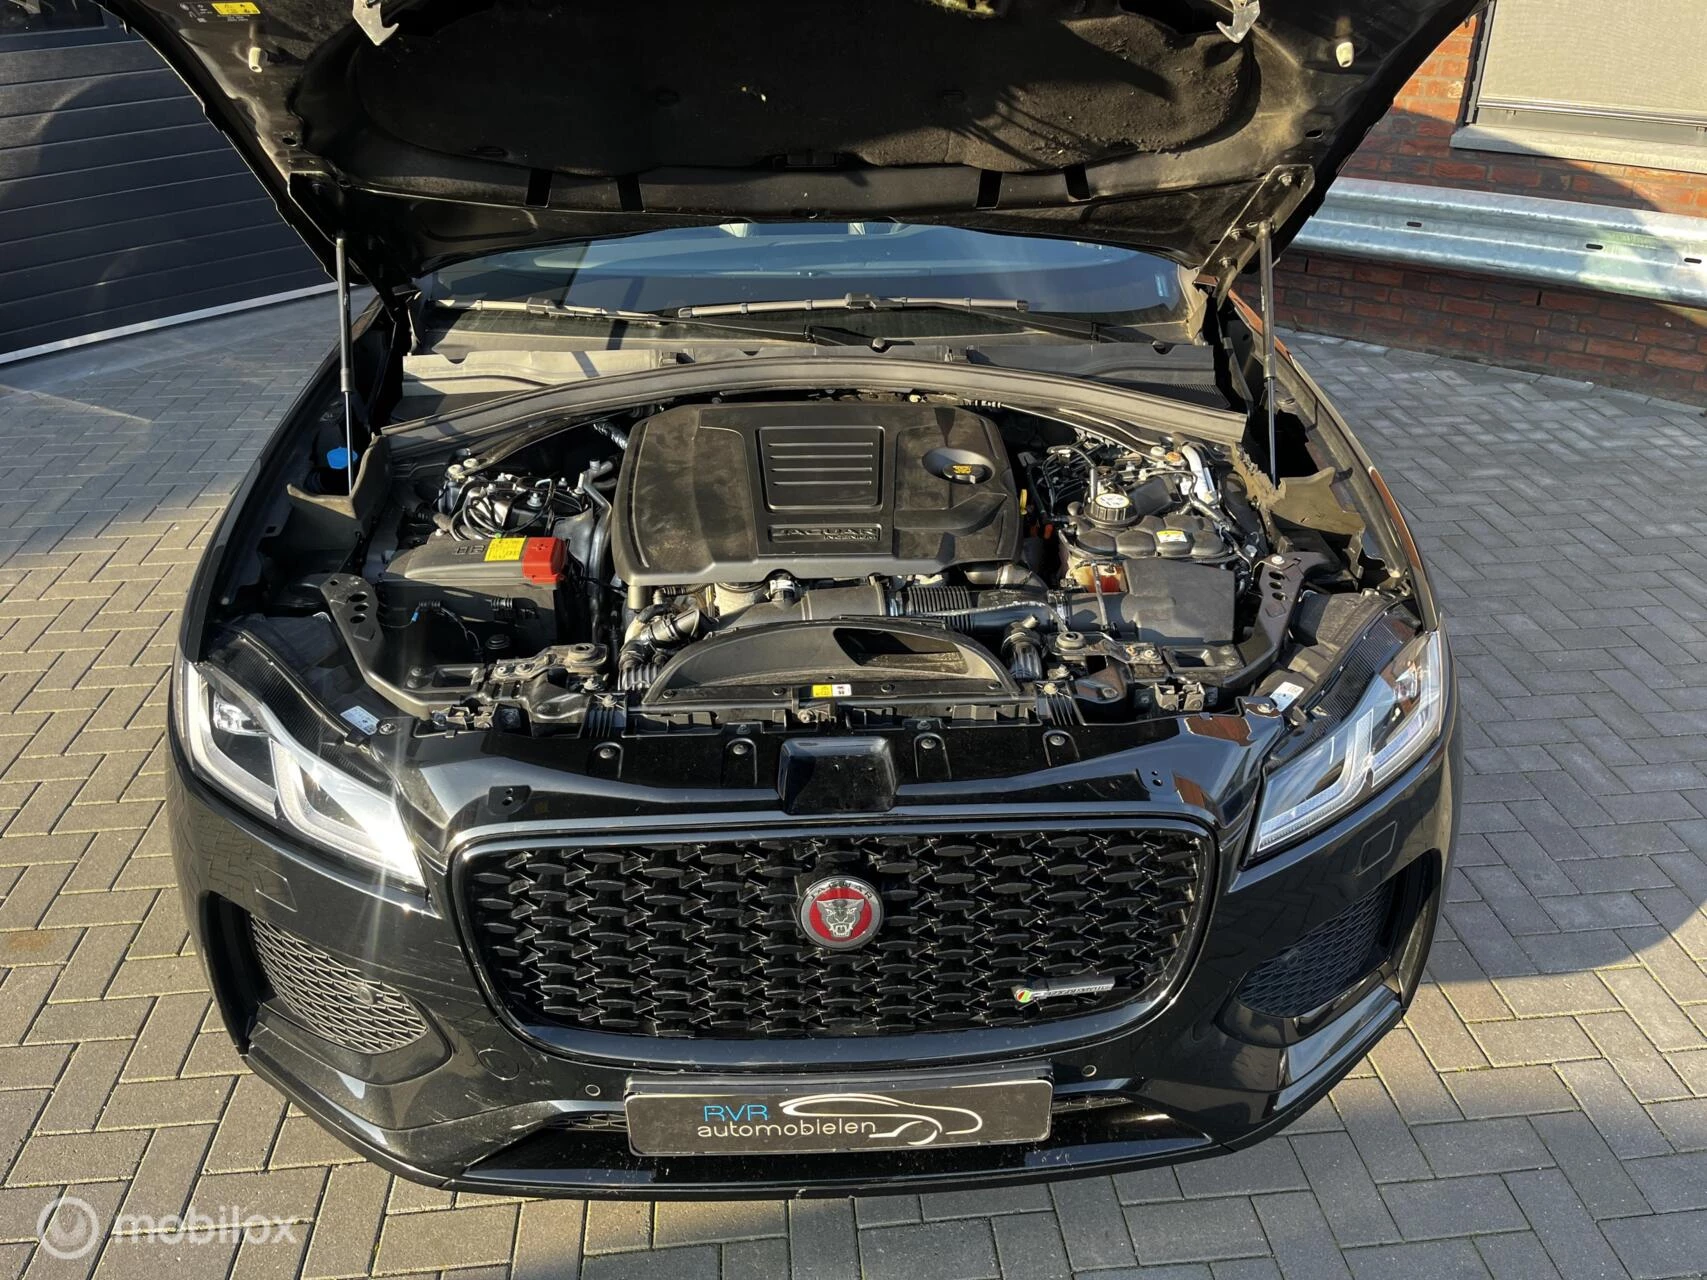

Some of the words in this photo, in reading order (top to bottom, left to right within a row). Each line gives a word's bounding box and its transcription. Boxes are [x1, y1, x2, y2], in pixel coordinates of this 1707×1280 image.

[810, 880, 874, 900] JAGUAR
[703, 1104, 768, 1122] RVR
[697, 1119, 876, 1138] automobielen
